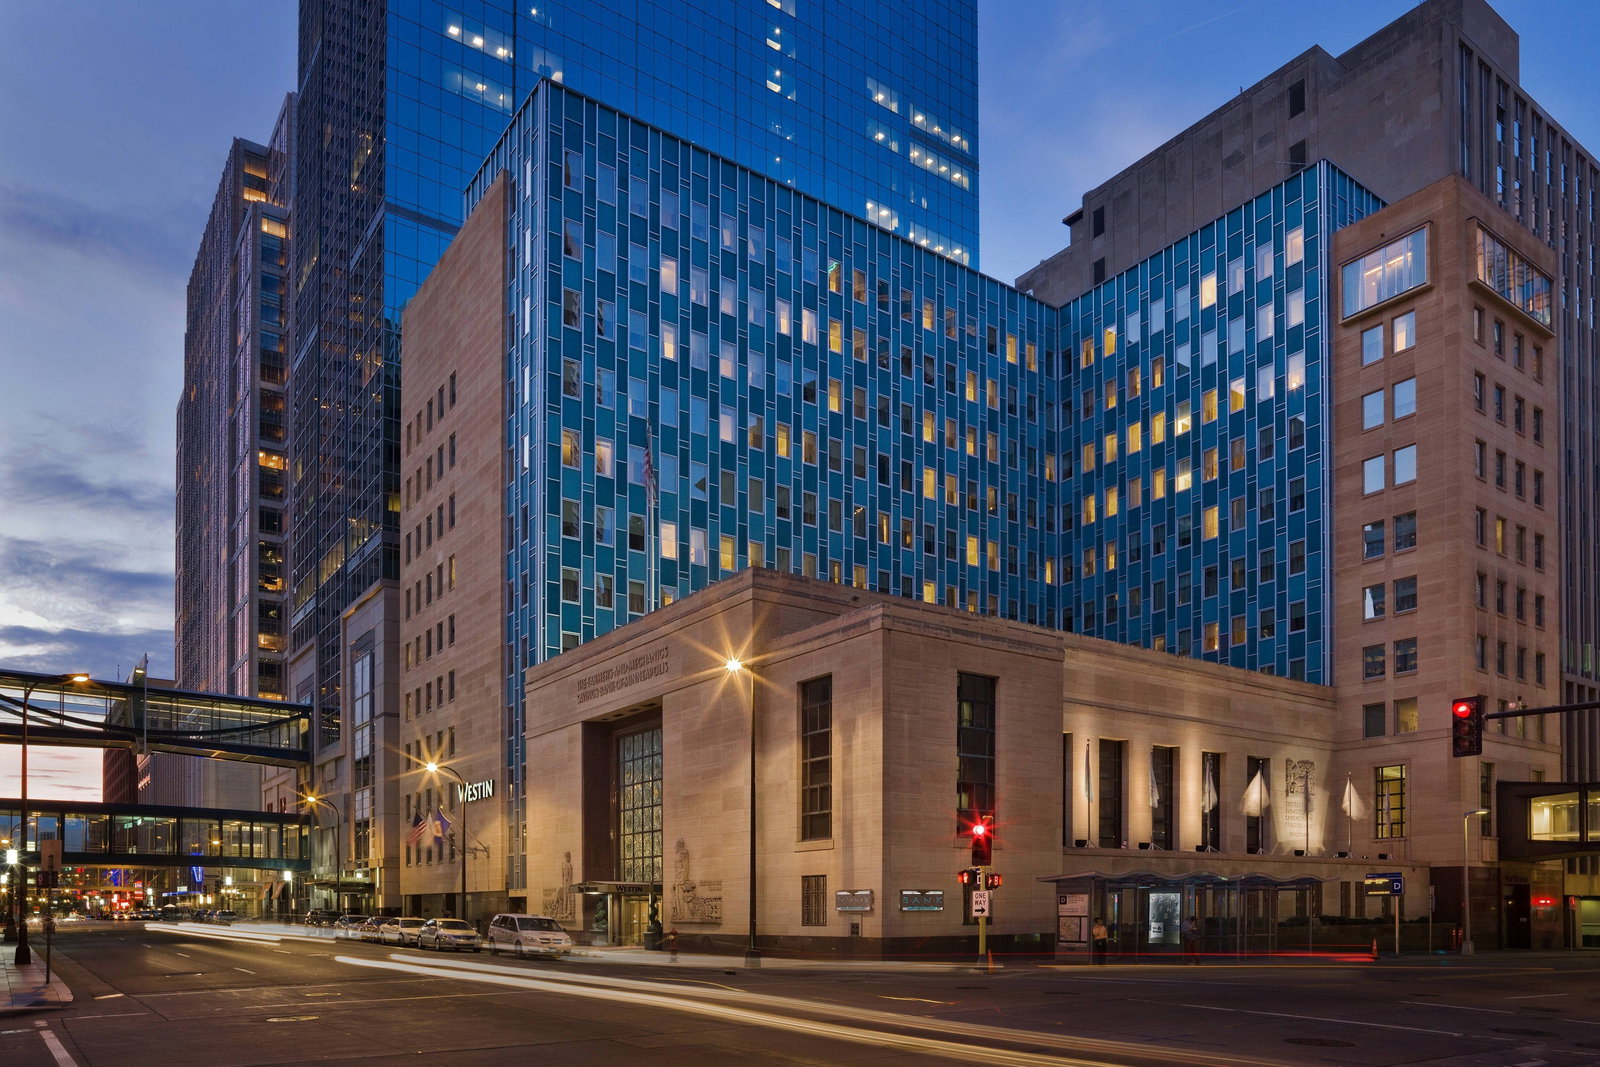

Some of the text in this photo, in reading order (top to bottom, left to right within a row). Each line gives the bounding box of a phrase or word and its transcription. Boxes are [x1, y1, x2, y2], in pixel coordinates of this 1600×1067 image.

[457, 779, 494, 803] WESTIN
[616, 885, 643, 893] WESTIN
[903, 896, 943, 905] BANK
